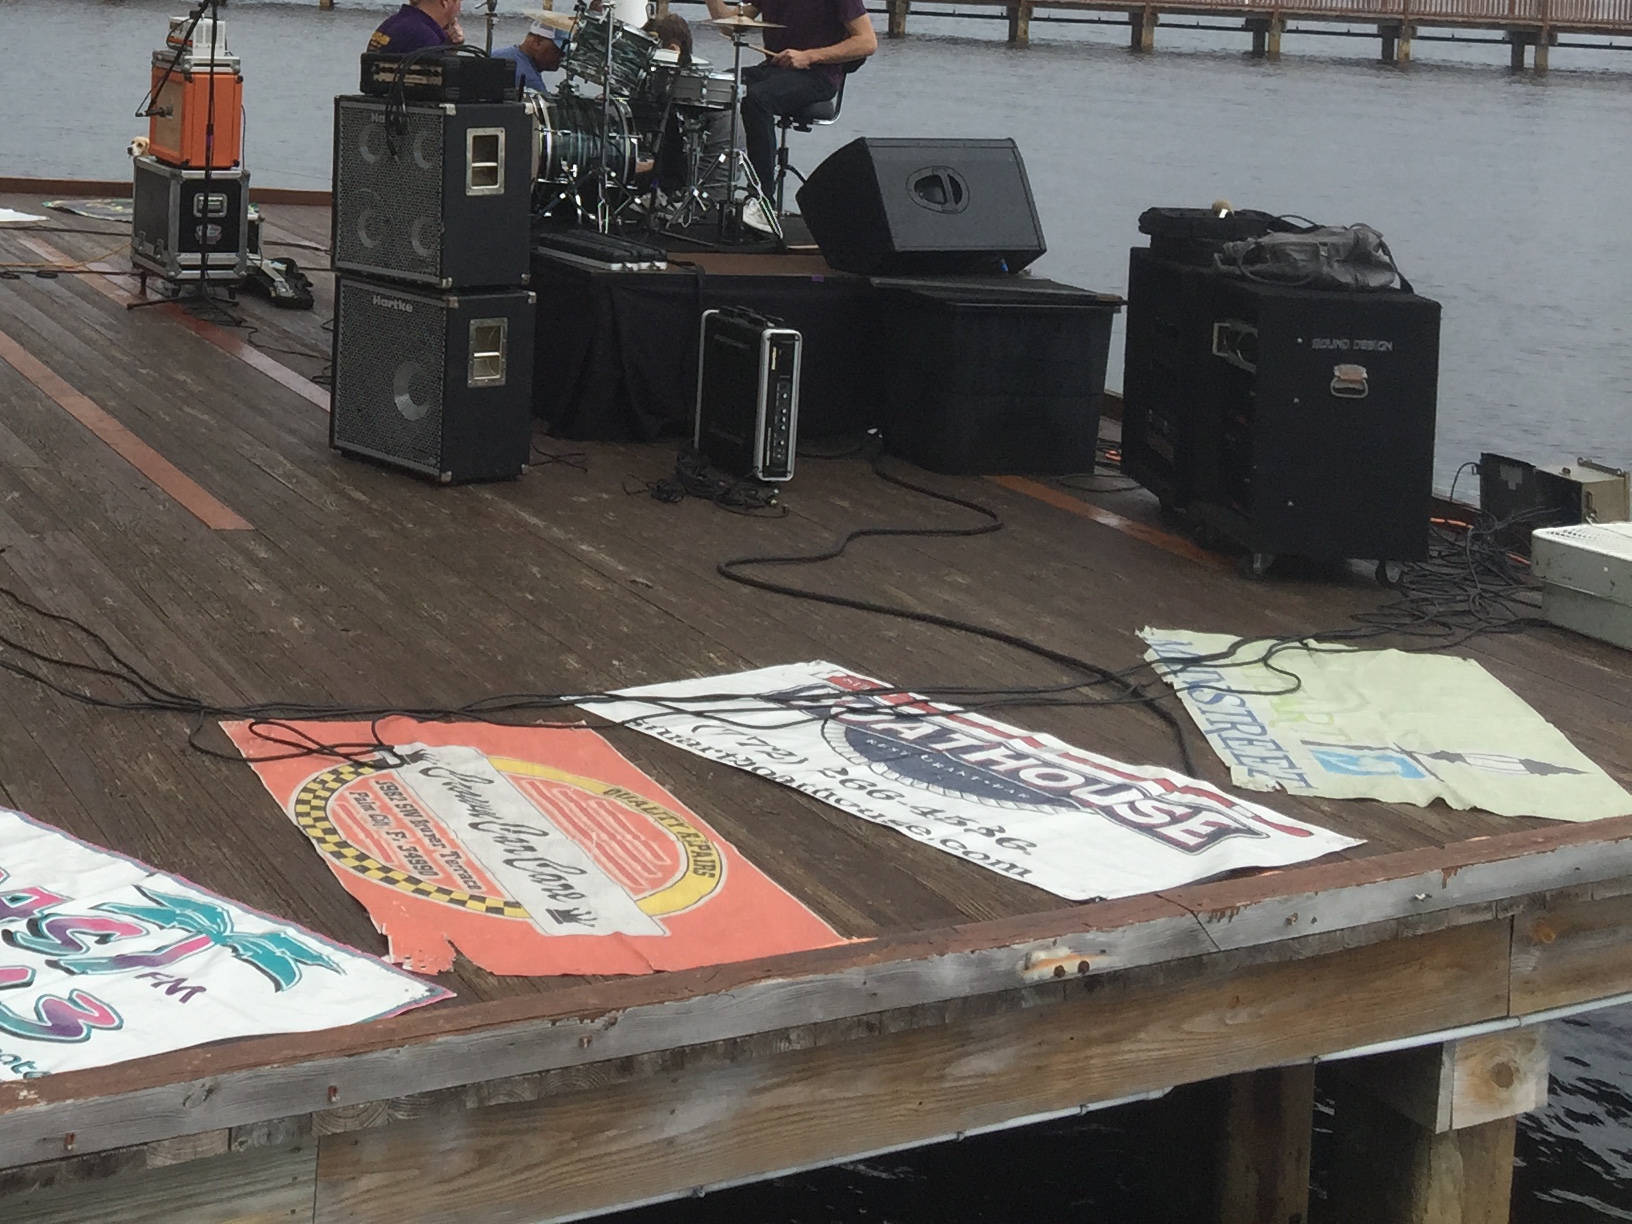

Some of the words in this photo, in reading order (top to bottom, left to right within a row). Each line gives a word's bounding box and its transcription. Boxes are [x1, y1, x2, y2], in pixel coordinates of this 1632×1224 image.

[373, 294, 414, 313] Hartke
[1312, 338, 1350, 350] SOUND
[1352, 339, 1394, 352] DESIGN
